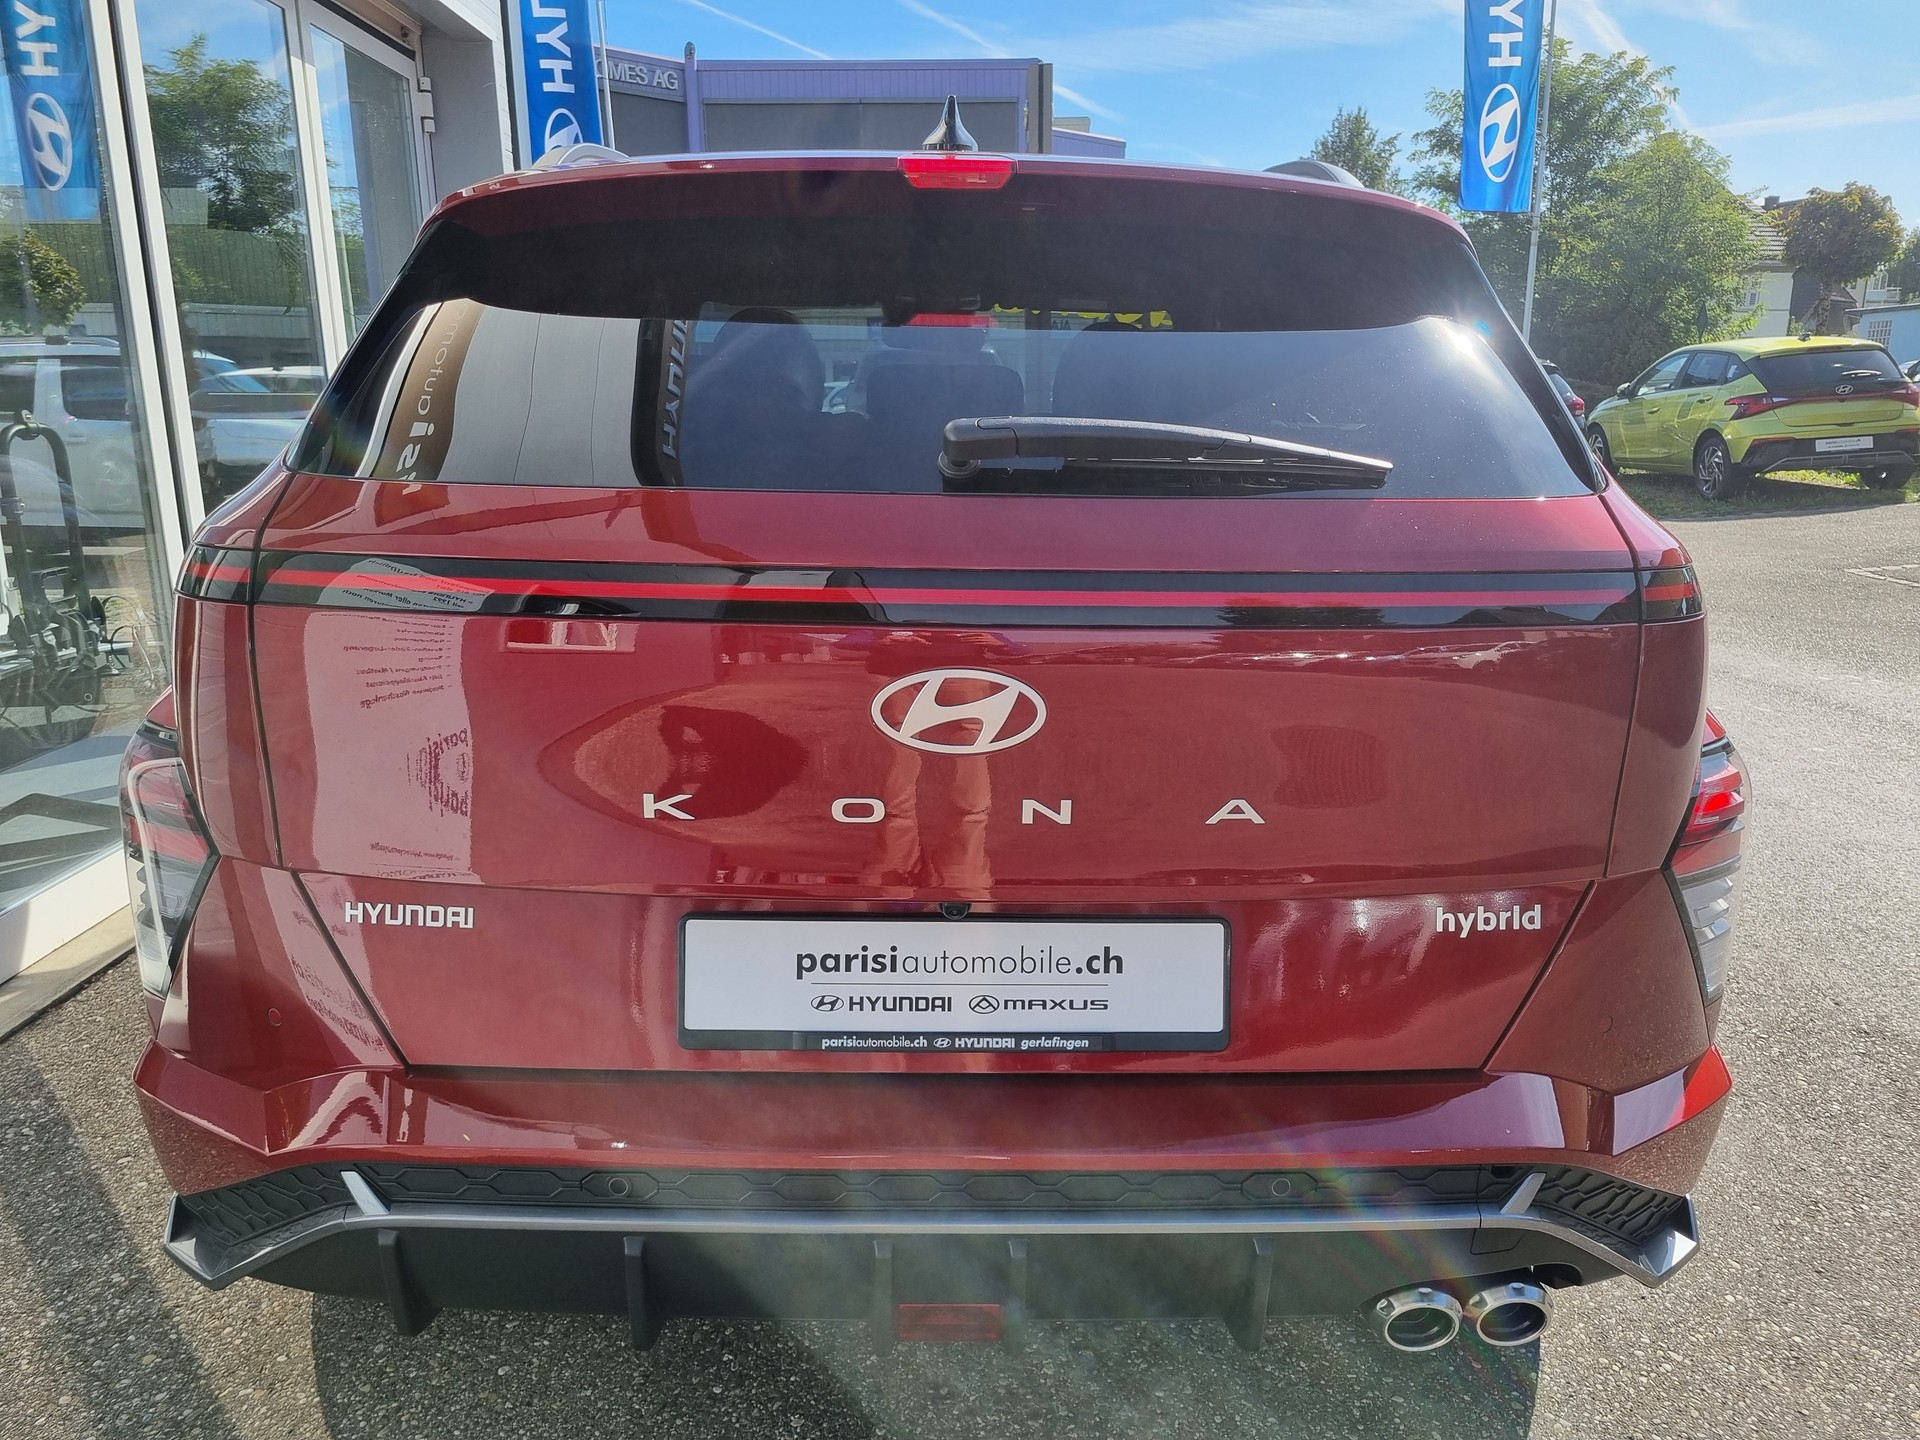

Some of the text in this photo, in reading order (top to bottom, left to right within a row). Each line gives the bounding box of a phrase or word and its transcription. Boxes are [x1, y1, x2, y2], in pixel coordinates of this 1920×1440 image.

[652, 69, 678, 90] AG
[641, 793, 1266, 826] KONA
[345, 902, 474, 929] HYUNDAI
[1436, 904, 1541, 938] hybrid
[796, 944, 1124, 980] parisiautomobile.ch
[848, 996, 1109, 1012] HYUNDAI MAXUS
[821, 1035, 1089, 1050] parisiautomobile.ch HYUNDAI gerlafingen
